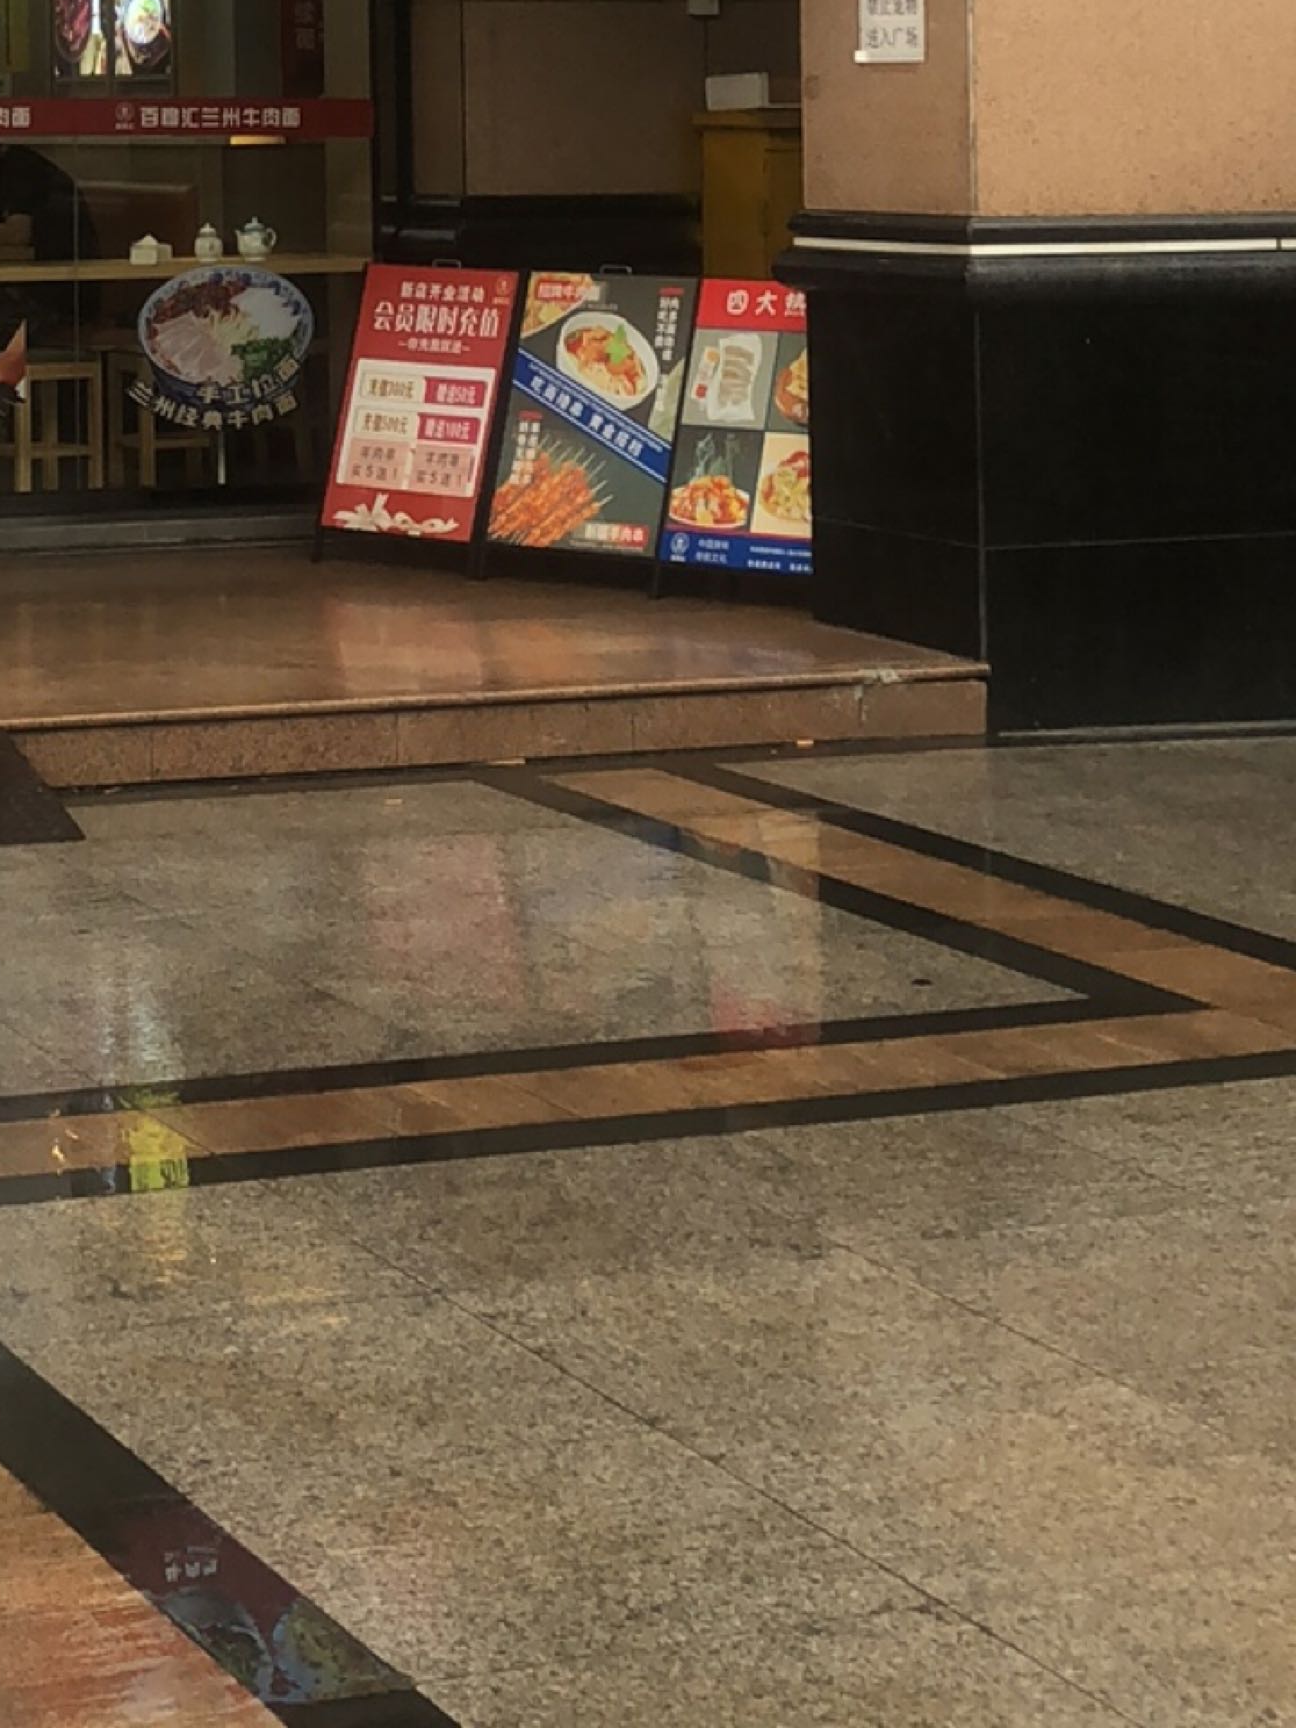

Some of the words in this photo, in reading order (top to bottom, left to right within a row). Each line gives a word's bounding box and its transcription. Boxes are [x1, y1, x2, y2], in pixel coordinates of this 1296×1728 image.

[373, 301, 500, 338] 会员限时充值
